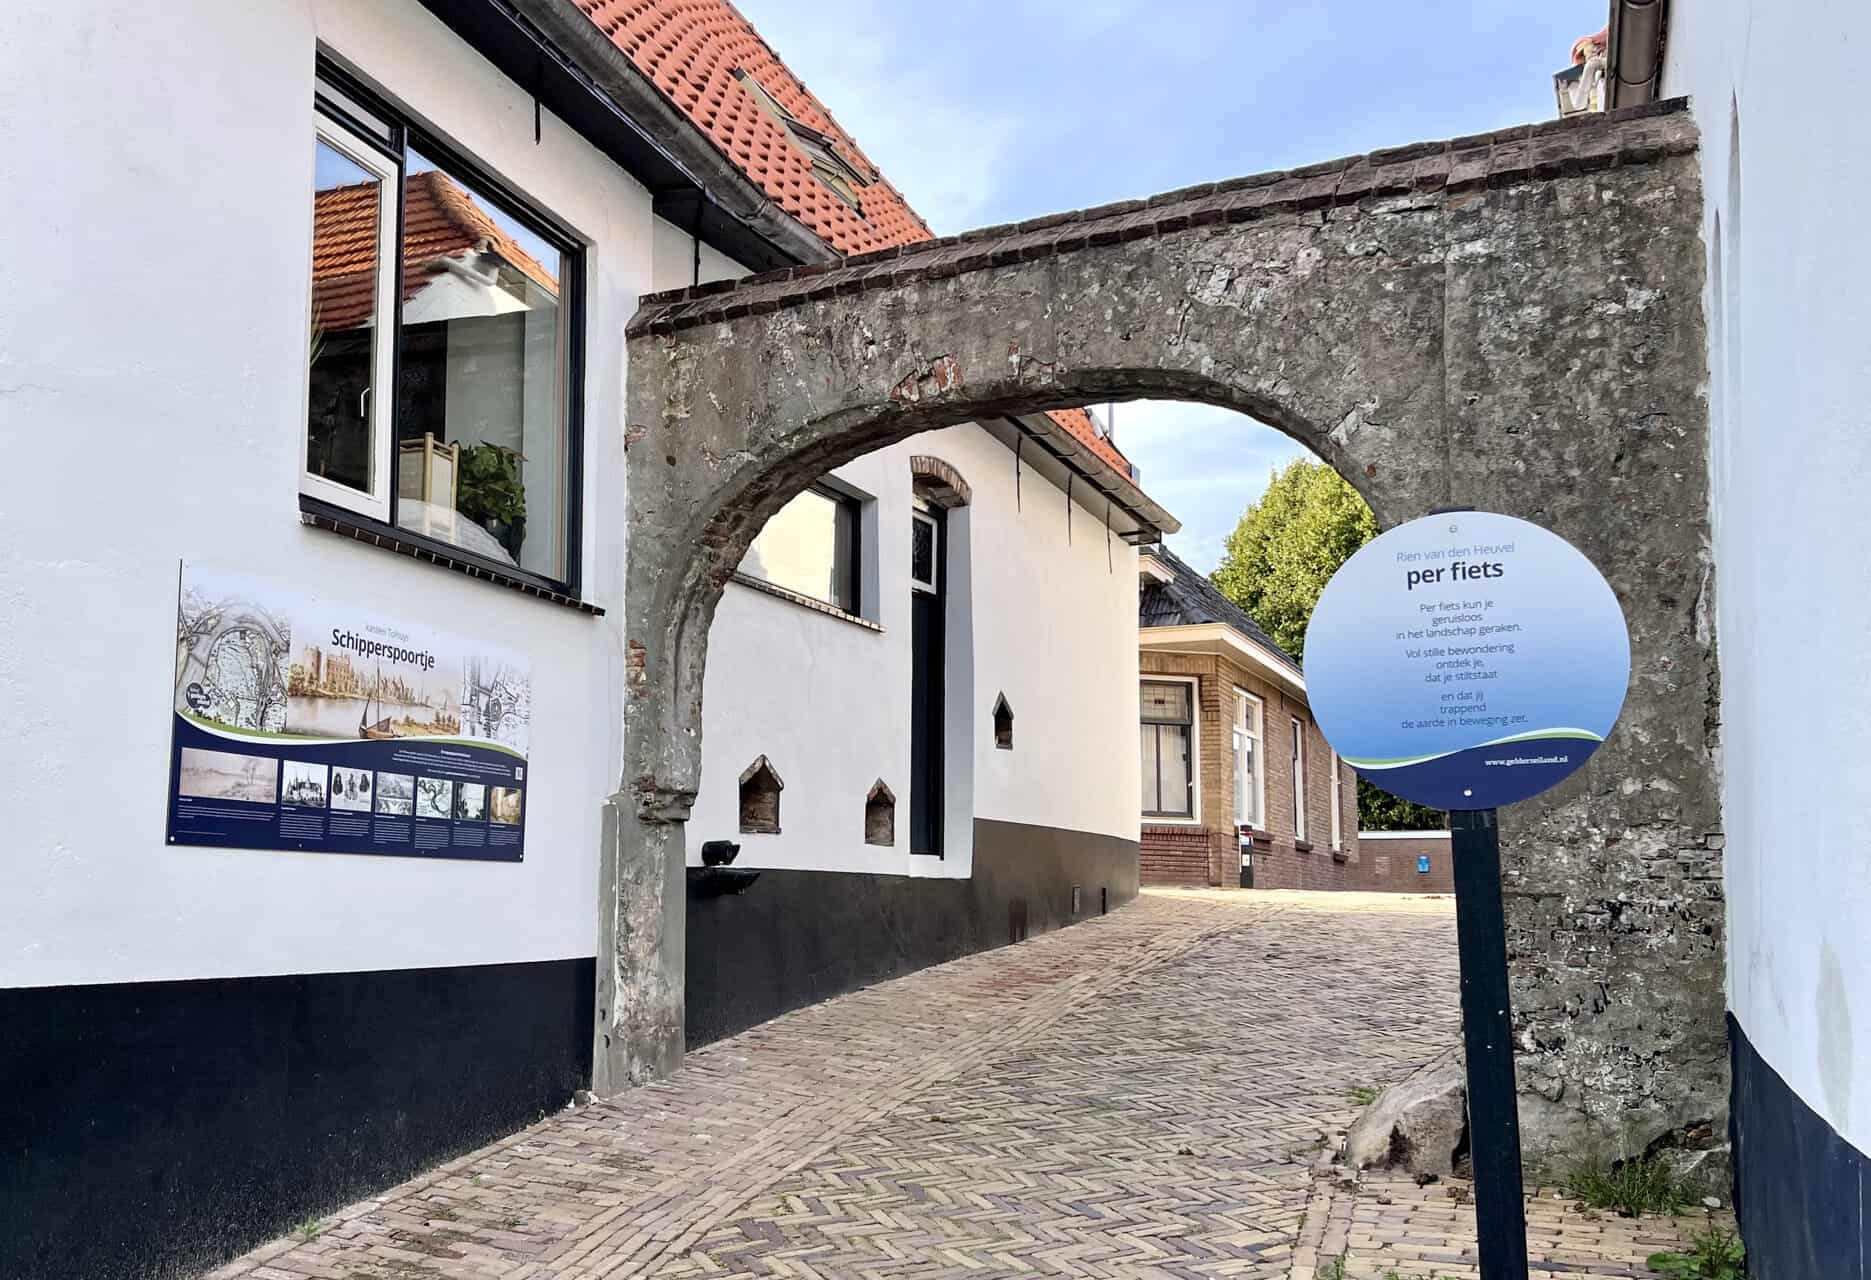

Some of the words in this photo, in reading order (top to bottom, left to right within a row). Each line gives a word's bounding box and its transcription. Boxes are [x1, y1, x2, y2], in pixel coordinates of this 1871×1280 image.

[1396, 551, 1421, 562] Rien
[1424, 550, 1444, 560] van
[1448, 548, 1470, 558] den
[1474, 542, 1514, 554] Heuvel
[1408, 568, 1445, 591] per
[1450, 561, 1503, 580] fiets
[1420, 603, 1435, 612] Per
[1439, 602, 1460, 611] fiets
[1463, 600, 1481, 609] kun
[1484, 600, 1494, 610] je
[1432, 614, 1483, 627] geruisloos
[1396, 632, 1404, 640] in
[1408, 630, 1423, 638] het
[1426, 626, 1477, 637] landschap
[1479, 624, 1523, 636] geraken.
[332, 629, 435, 671] Schipperspoortje
[1406, 648, 1420, 658] Vol
[1424, 647, 1445, 657] stille
[1448, 644, 1515, 656] bewondering
[1436, 659, 1471, 669] ontdek
[1425, 673, 1441, 682] dat
[1443, 674, 1453, 683] je
[1441, 692, 1454, 701] en
[1457, 690, 1472, 700] dat
[1475, 690, 1483, 702] jij
[1440, 703, 1486, 715] trappend
[1402, 720, 1414, 728] de
[1417, 719, 1445, 728] aarde
[1447, 718, 1456, 727] in
[1459, 716, 1508, 727] beweging
